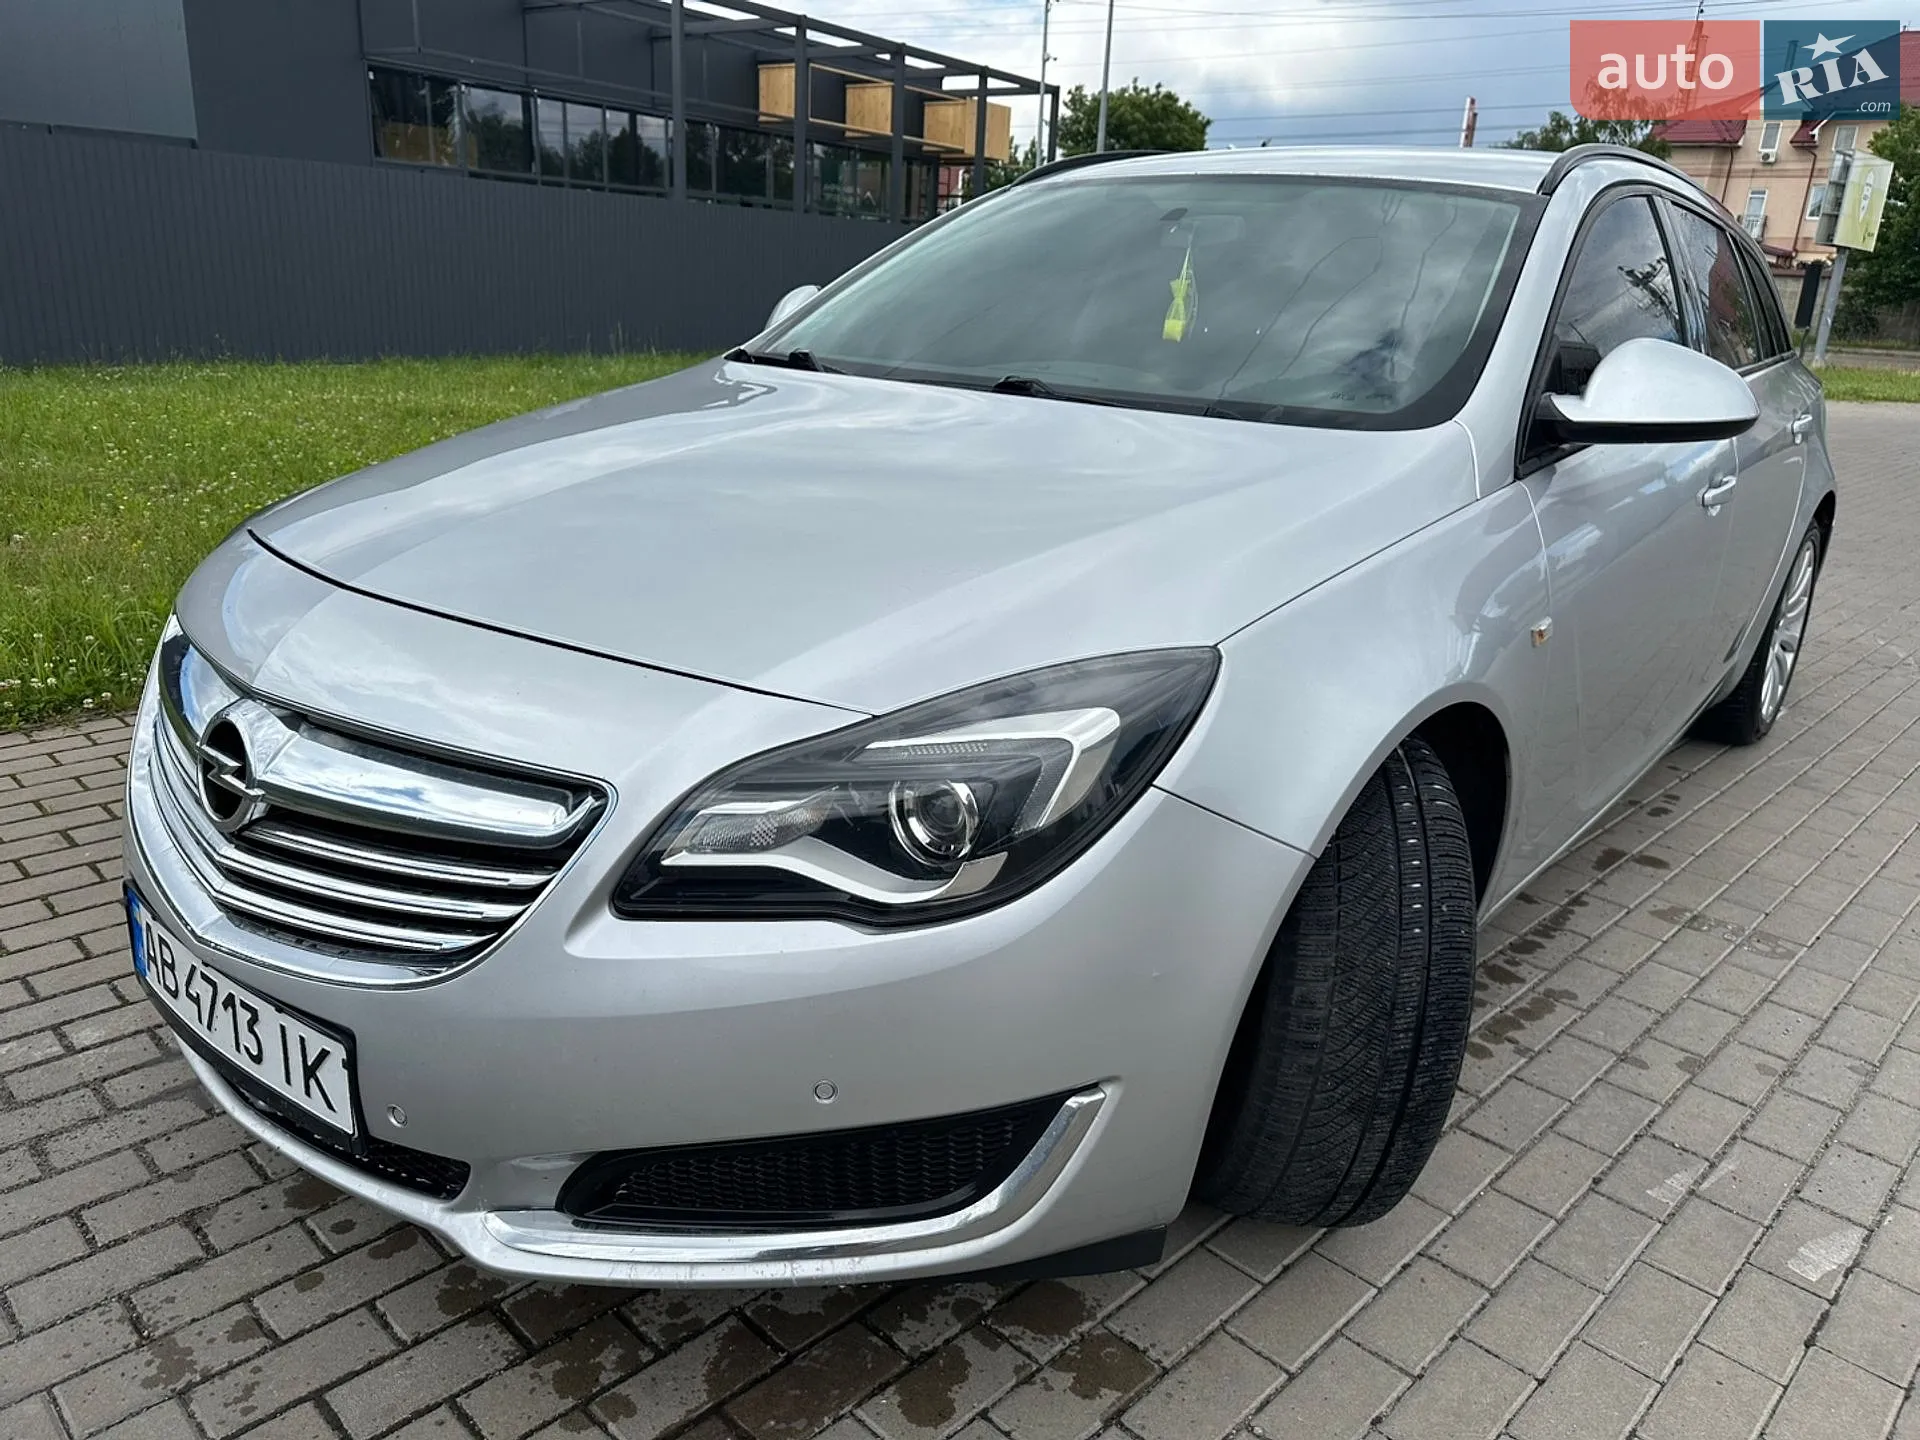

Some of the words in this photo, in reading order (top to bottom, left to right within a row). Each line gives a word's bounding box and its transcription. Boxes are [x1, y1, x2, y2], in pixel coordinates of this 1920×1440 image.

[145, 920, 179, 1000] AB
[185, 963, 264, 1065] 4713
[279, 1022, 337, 1114] IK
